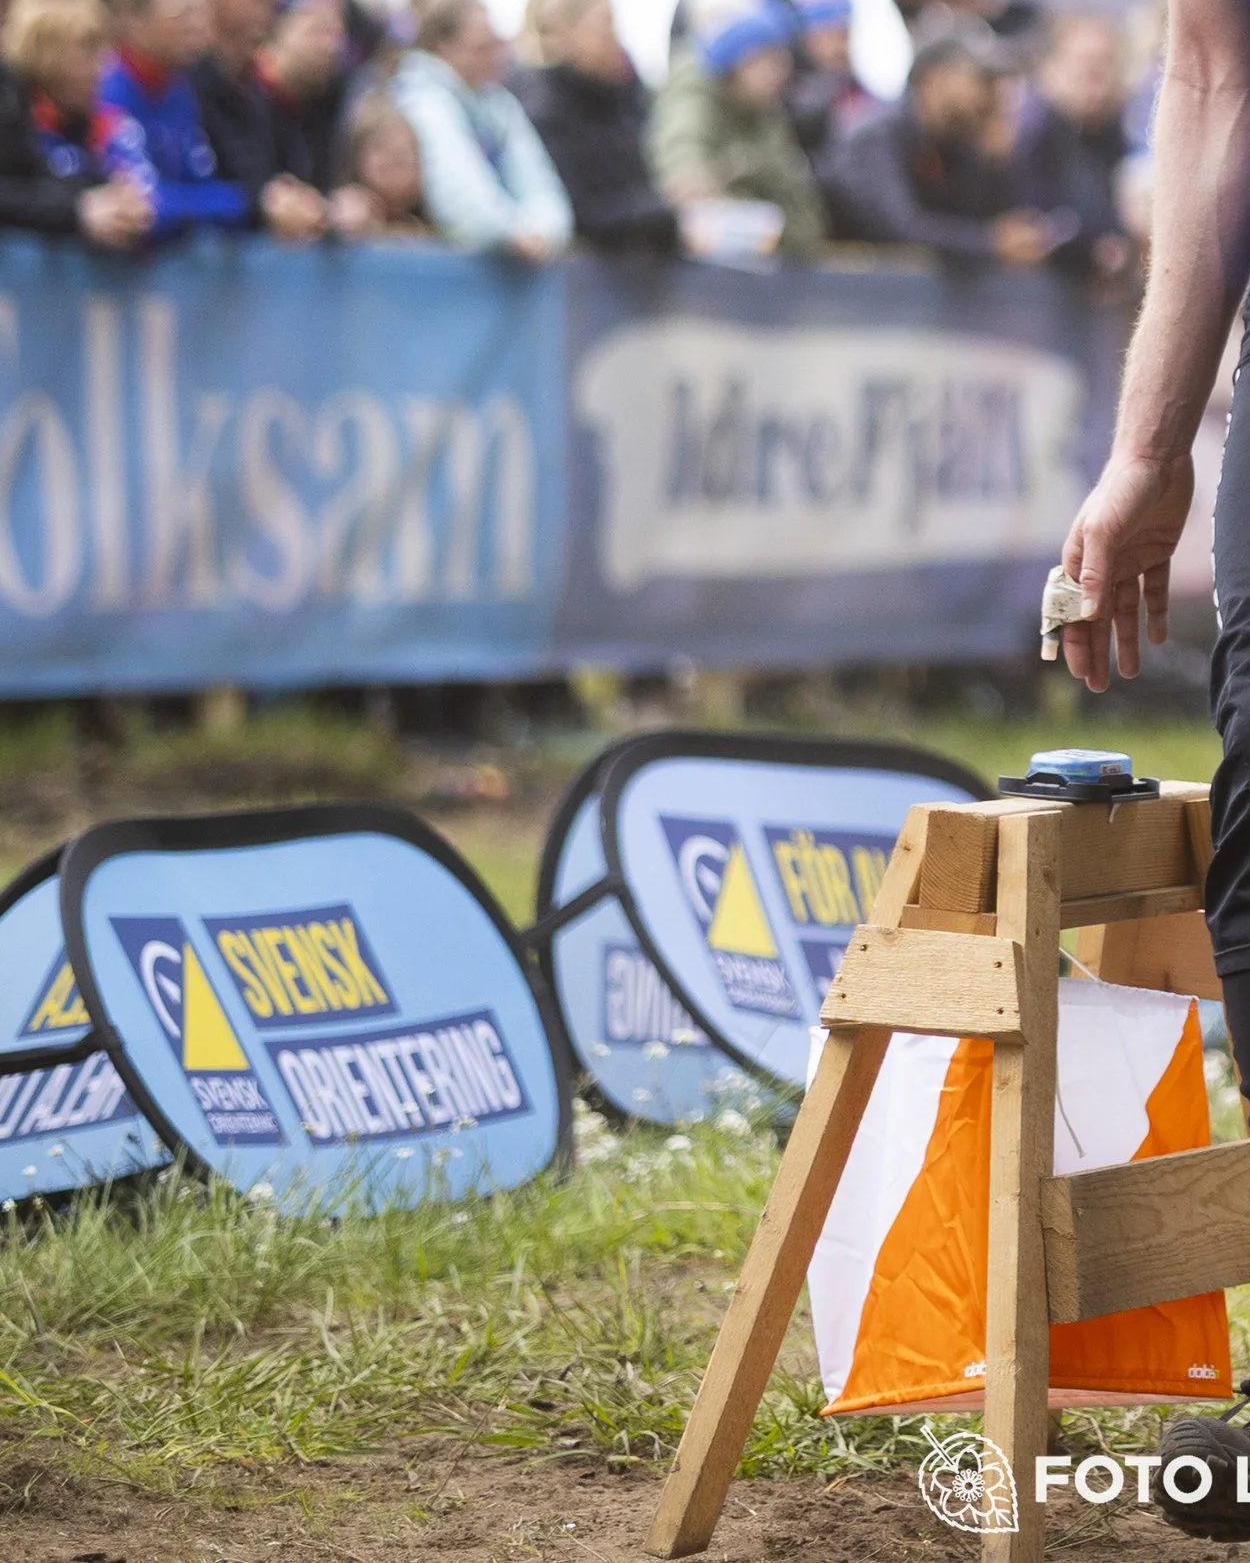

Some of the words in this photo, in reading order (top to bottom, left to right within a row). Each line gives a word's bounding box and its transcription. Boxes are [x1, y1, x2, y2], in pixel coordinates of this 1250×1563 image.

[218, 917, 389, 1019] SVENSK
[191, 1076, 270, 1111] SVENSK
[277, 1018, 522, 1139] ORIENTERING
